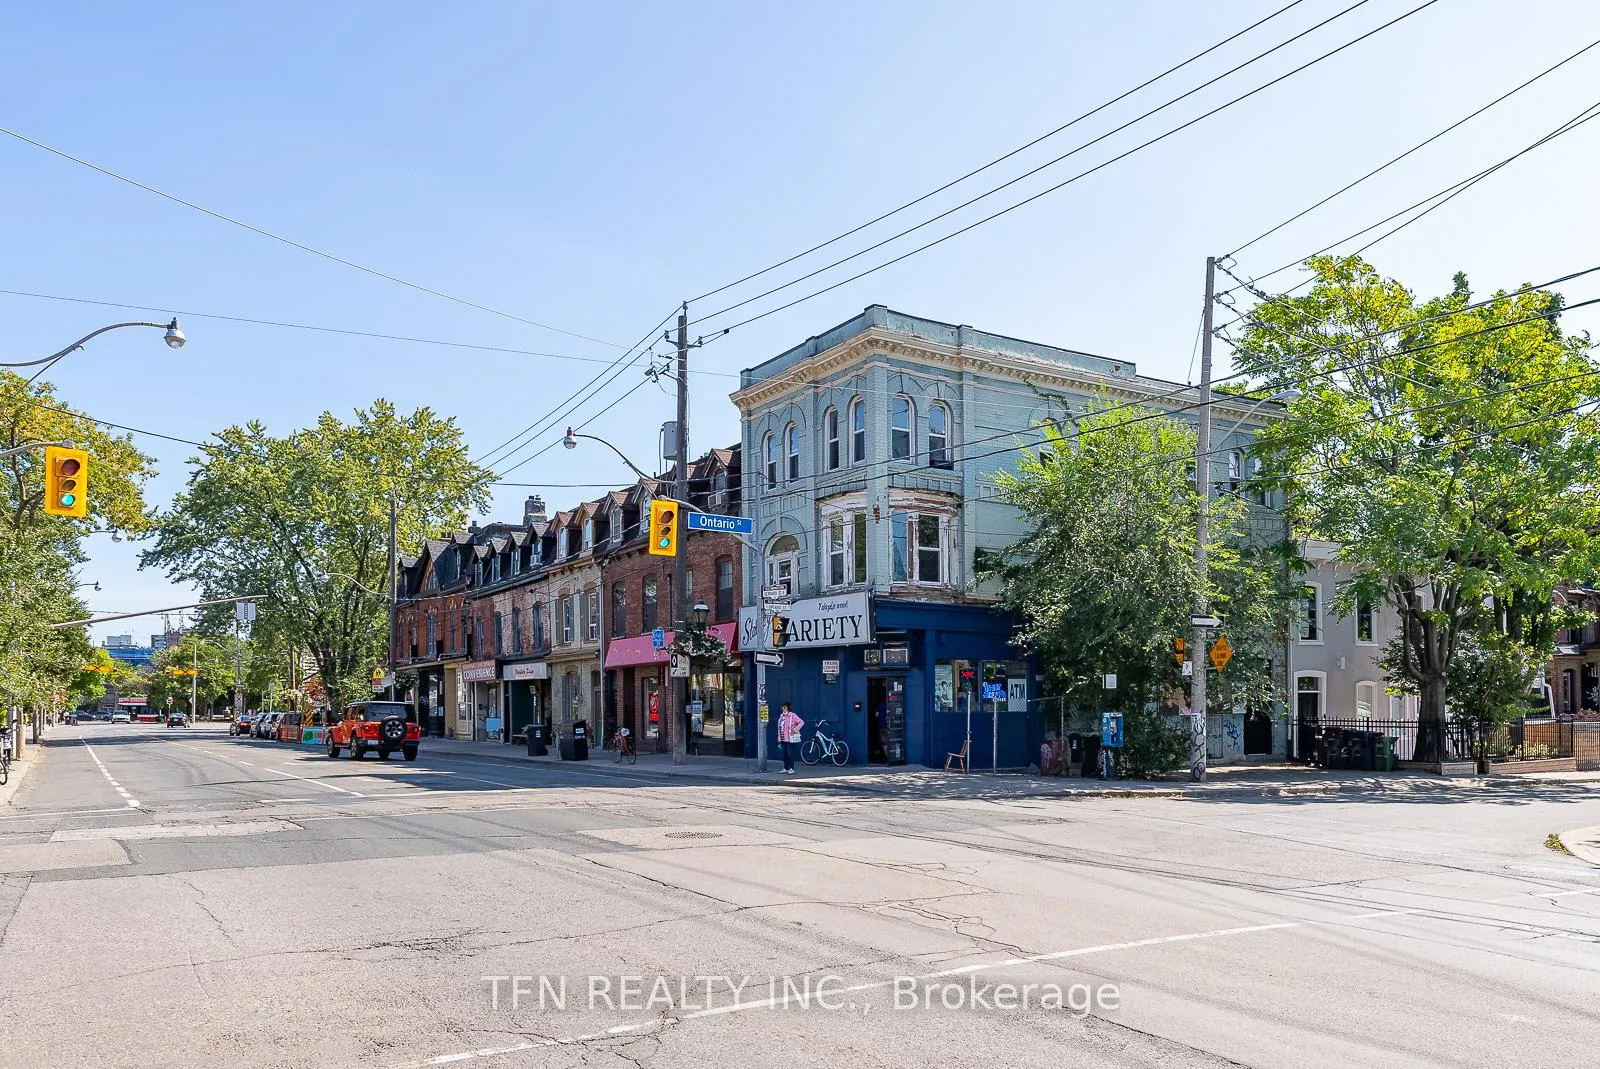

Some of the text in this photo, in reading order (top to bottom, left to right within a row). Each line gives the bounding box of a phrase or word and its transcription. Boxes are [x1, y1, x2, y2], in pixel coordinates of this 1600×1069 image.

[700, 516, 735, 529] Ontario
[463, 667, 496, 680] CONVENIENCE
[1010, 683, 1026, 699] ATM
